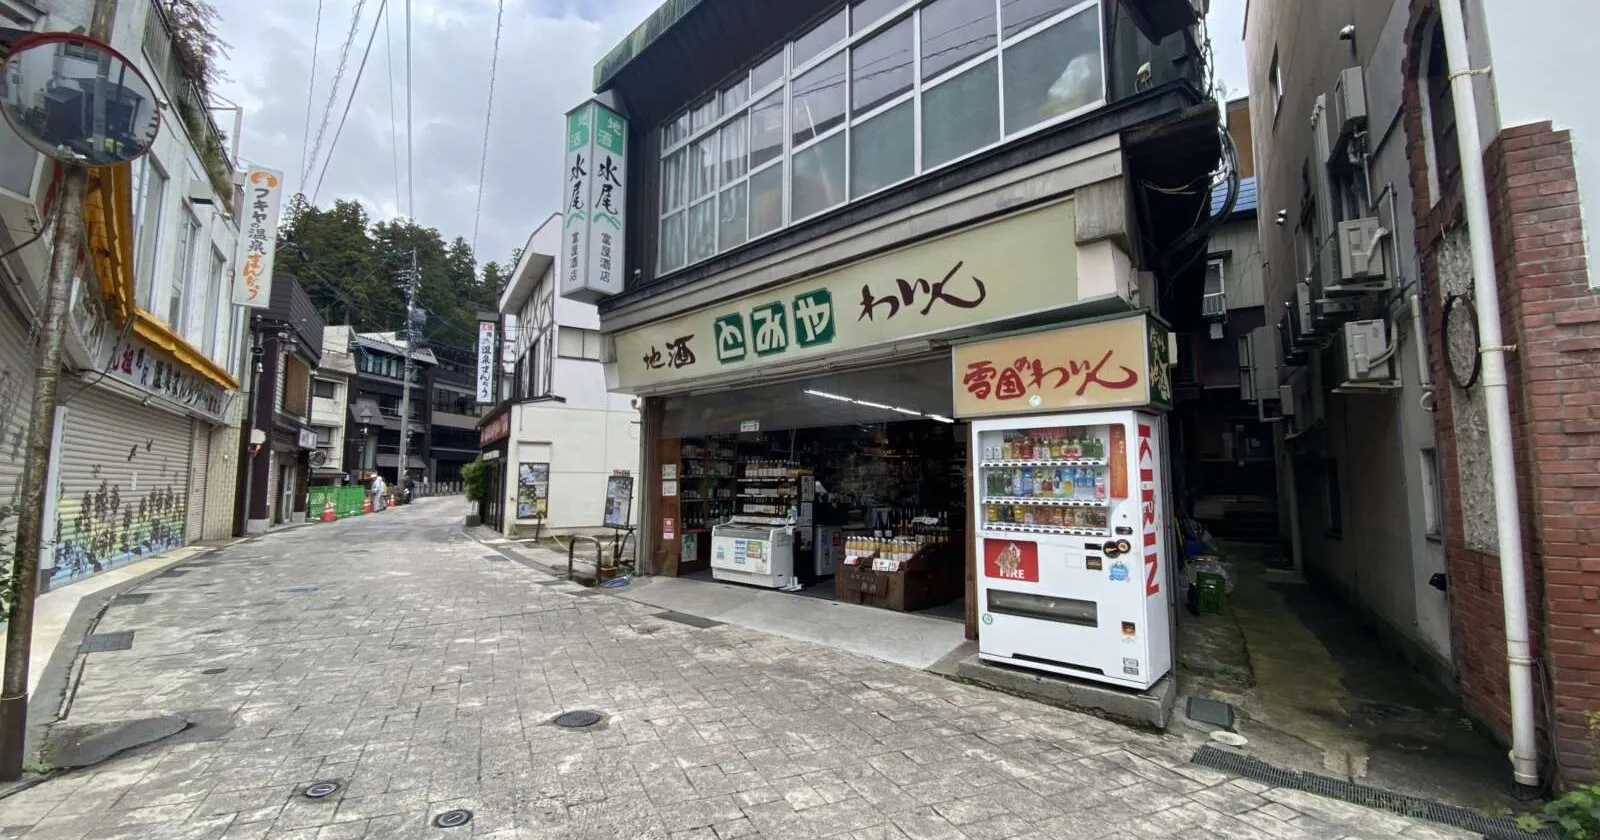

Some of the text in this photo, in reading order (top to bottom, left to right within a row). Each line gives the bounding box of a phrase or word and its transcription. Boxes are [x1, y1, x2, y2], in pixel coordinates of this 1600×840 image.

[598, 117, 622, 148] 地酒
[595, 155, 622, 215] 水尾
[599, 232, 612, 283] 富屋酒店
[858, 260, 986, 322] わいん
[643, 334, 696, 371] 地酒
[716, 292, 834, 361] とみや
[963, 349, 1138, 401] 雪国のわいん
[1138, 424, 1159, 597] KIRIN
